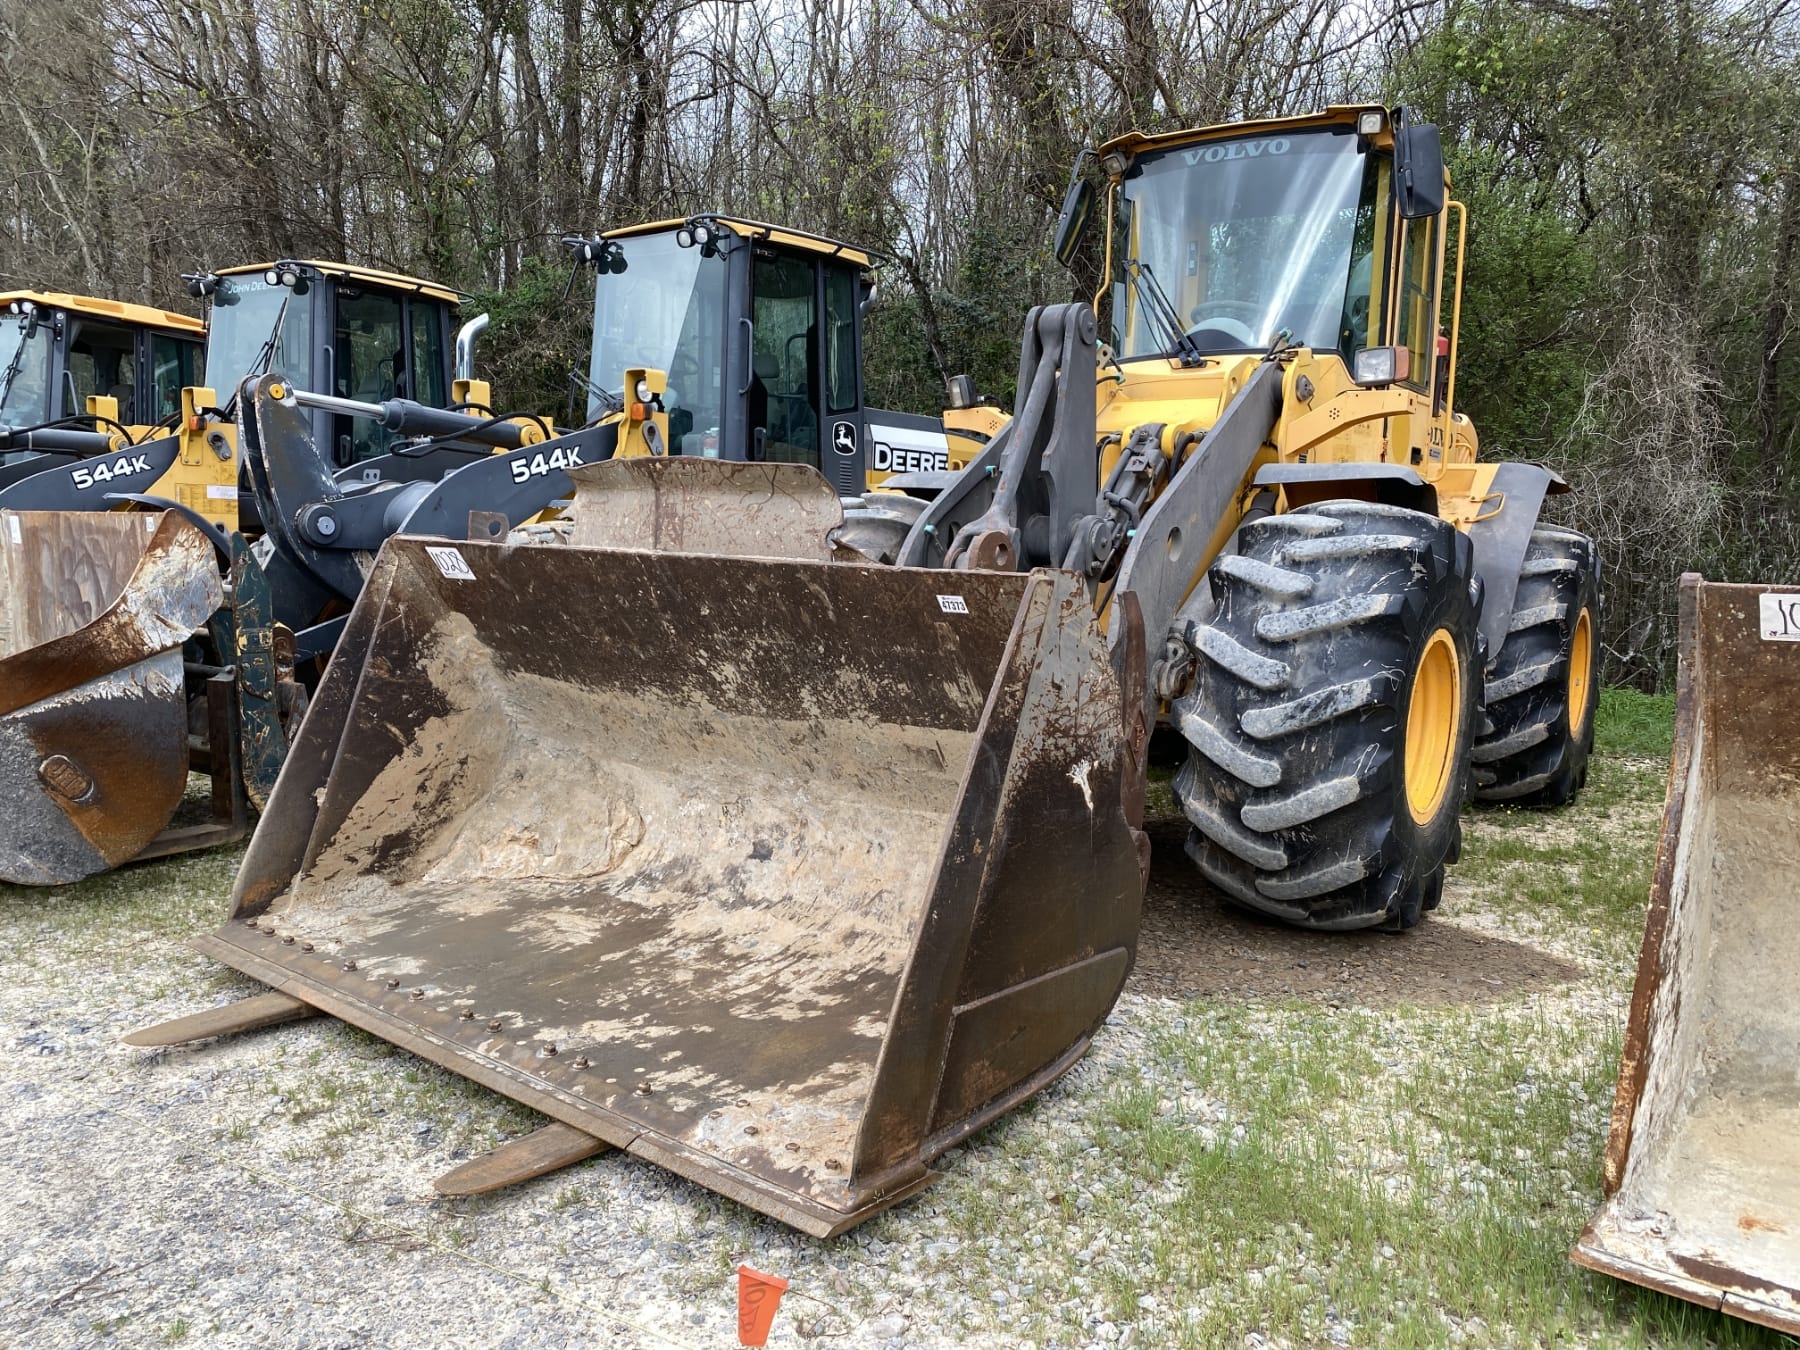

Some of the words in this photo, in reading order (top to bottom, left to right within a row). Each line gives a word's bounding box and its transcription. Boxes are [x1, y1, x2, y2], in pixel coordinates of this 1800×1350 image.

[1181, 138, 1291, 166] VOLVO
[228, 283, 250, 294] JOHN
[250, 280, 279, 292] DEE
[70, 453, 154, 490] 544K
[510, 445, 586, 484] 544K
[873, 440, 949, 473] DEERE
